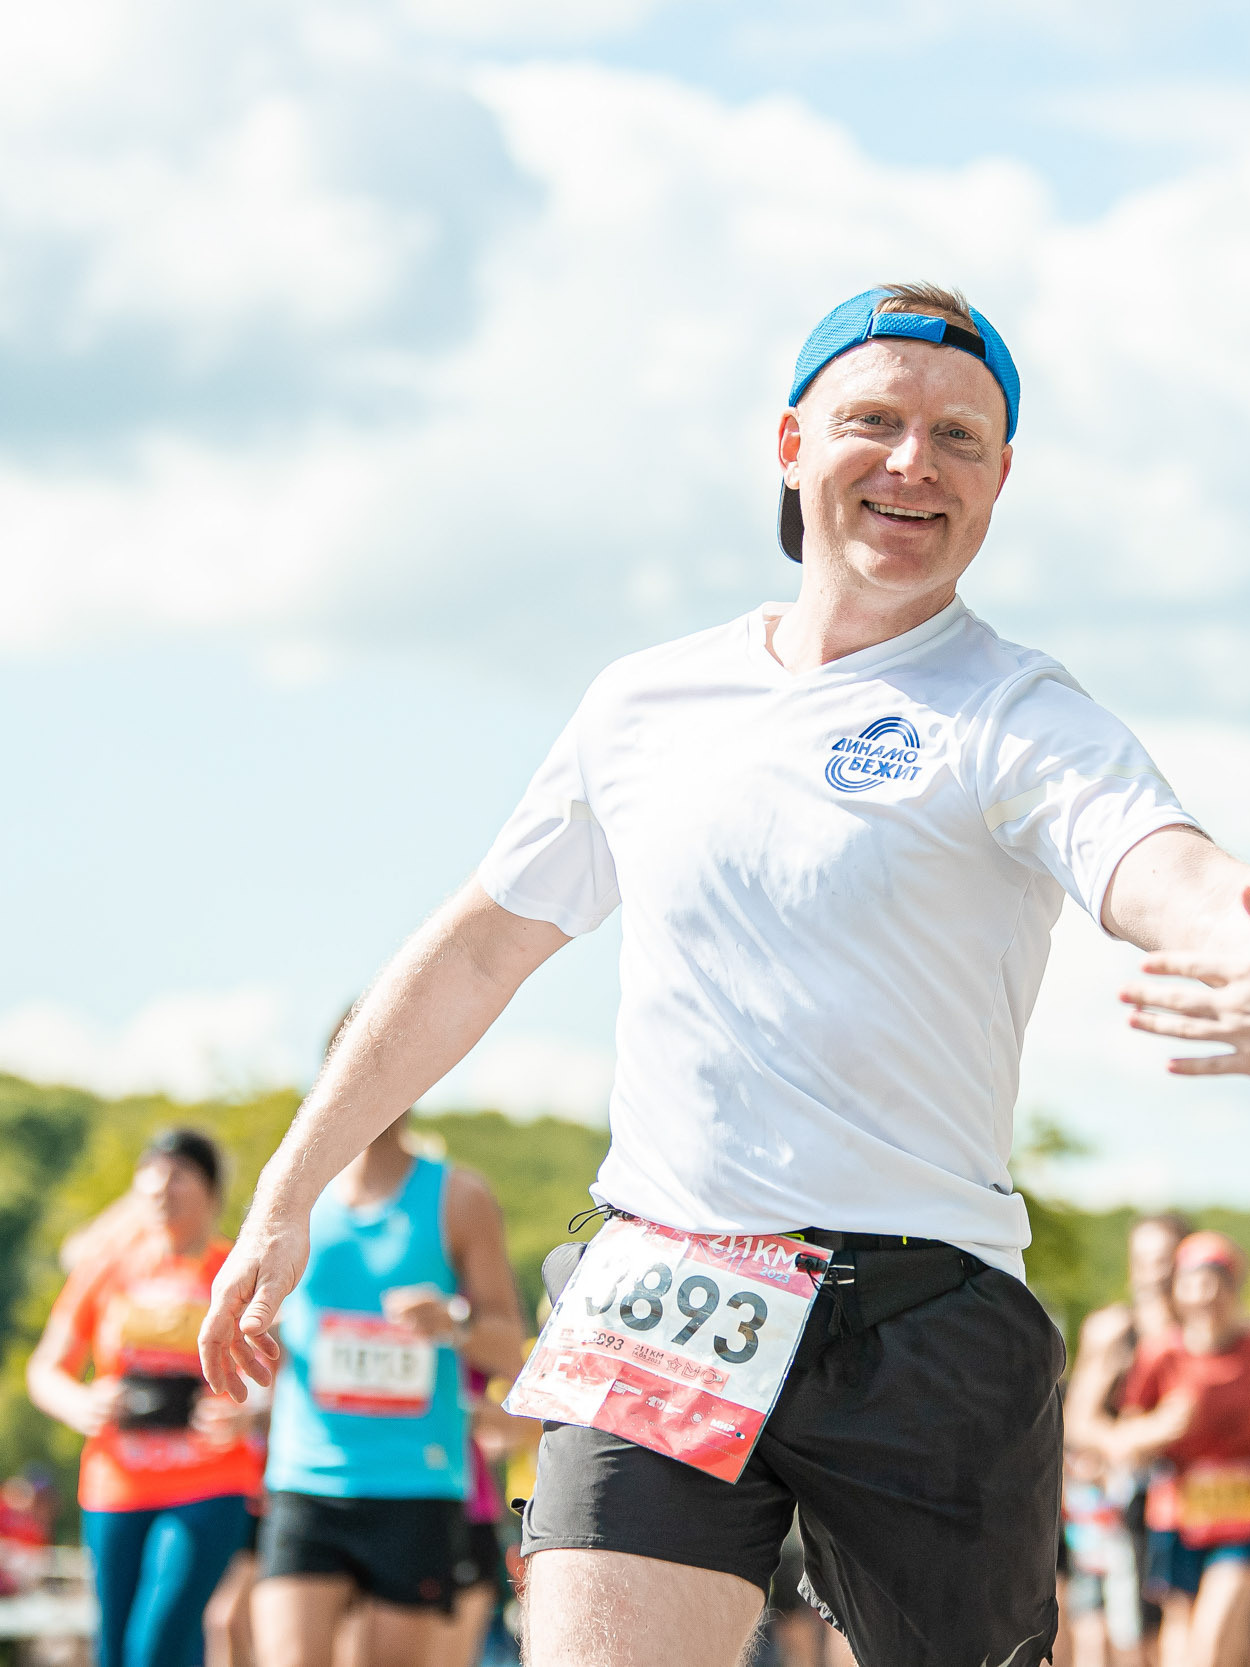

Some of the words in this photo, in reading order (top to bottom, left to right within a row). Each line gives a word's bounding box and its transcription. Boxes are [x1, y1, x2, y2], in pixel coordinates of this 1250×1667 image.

[832, 738, 918, 763] ДИНАМО
[848, 757, 922, 780] БЕЖИТ
[760, 1266, 790, 1284] 2023
[589, 1330, 624, 1350] 893
